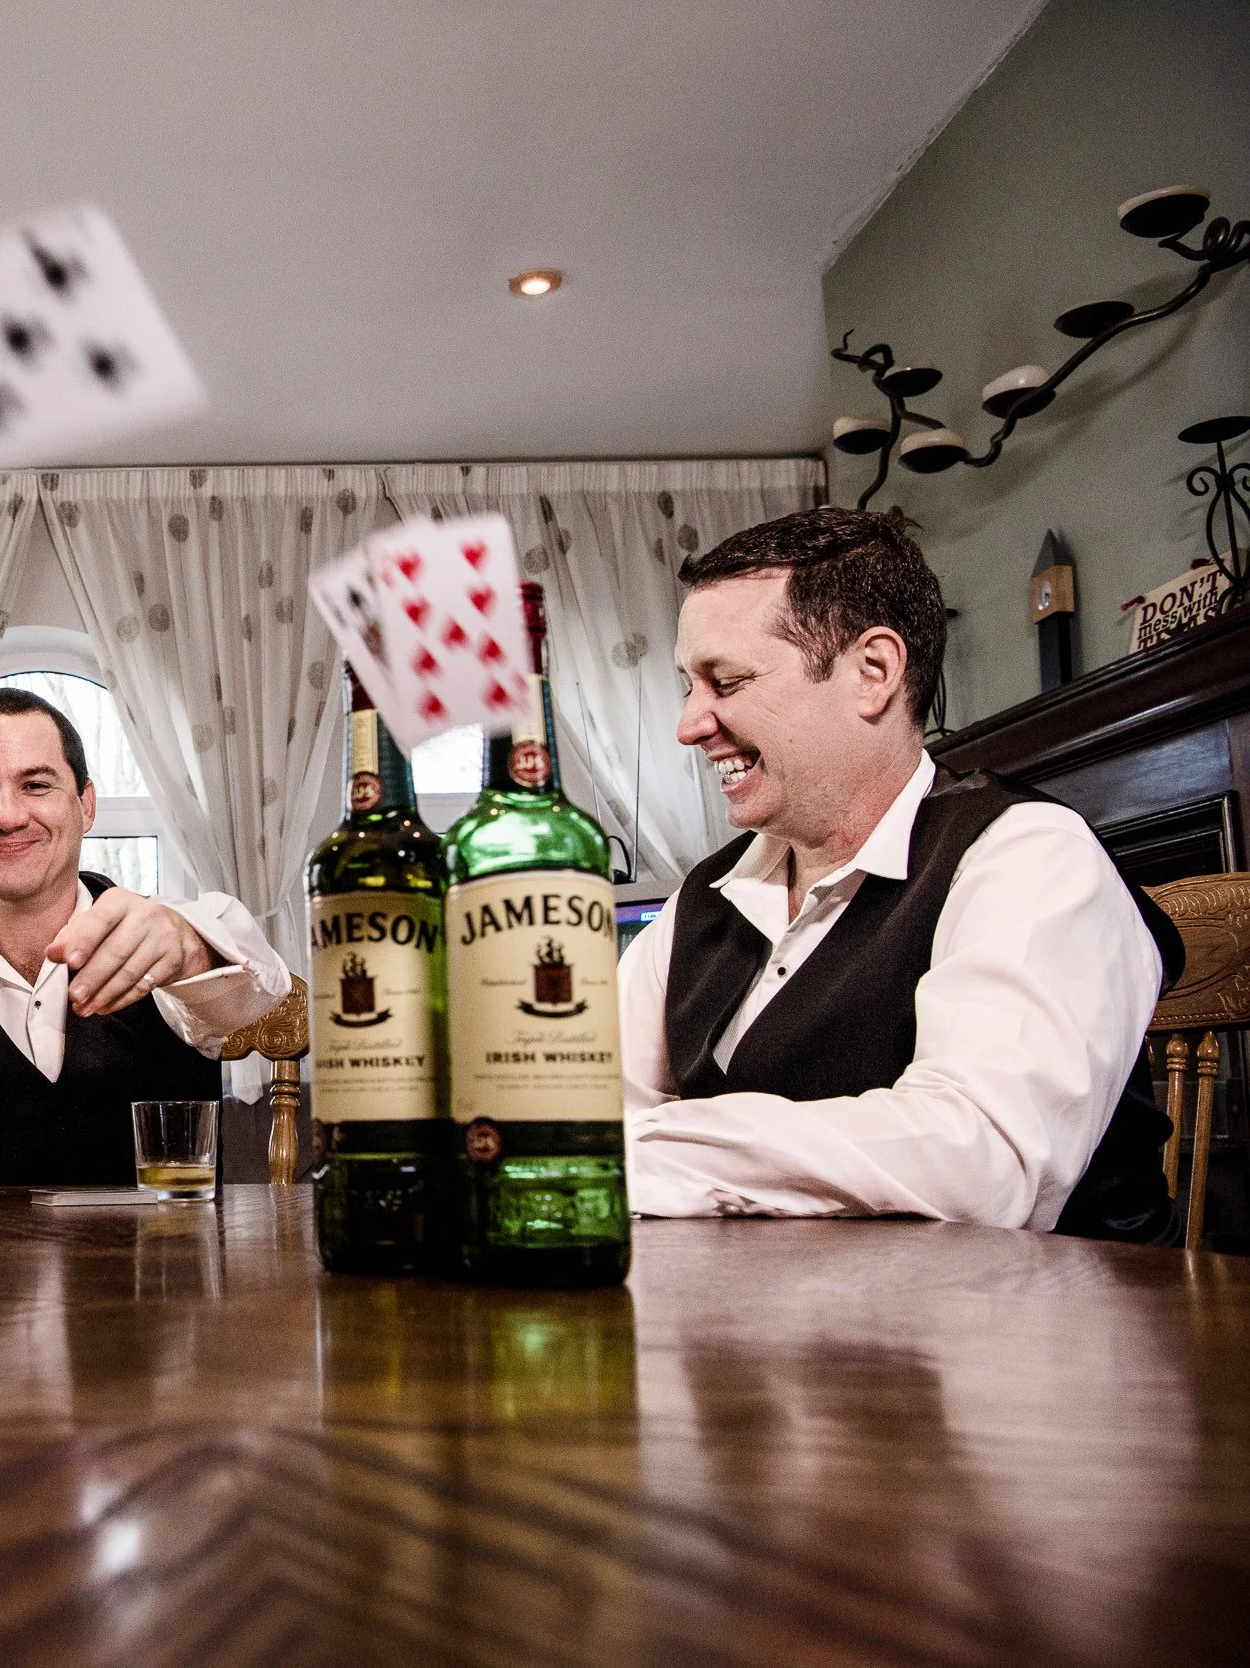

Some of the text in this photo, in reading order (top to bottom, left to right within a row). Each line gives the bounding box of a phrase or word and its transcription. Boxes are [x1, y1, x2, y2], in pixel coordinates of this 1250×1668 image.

[1138, 589, 1218, 640] mess with
[1140, 569, 1223, 626] DON'T
[311, 911, 439, 954] AMESON
[461, 894, 613, 945] JAMESON
[349, 1056, 425, 1068] WHISKEY
[486, 1051, 613, 1064] IRISH WHISKEY
